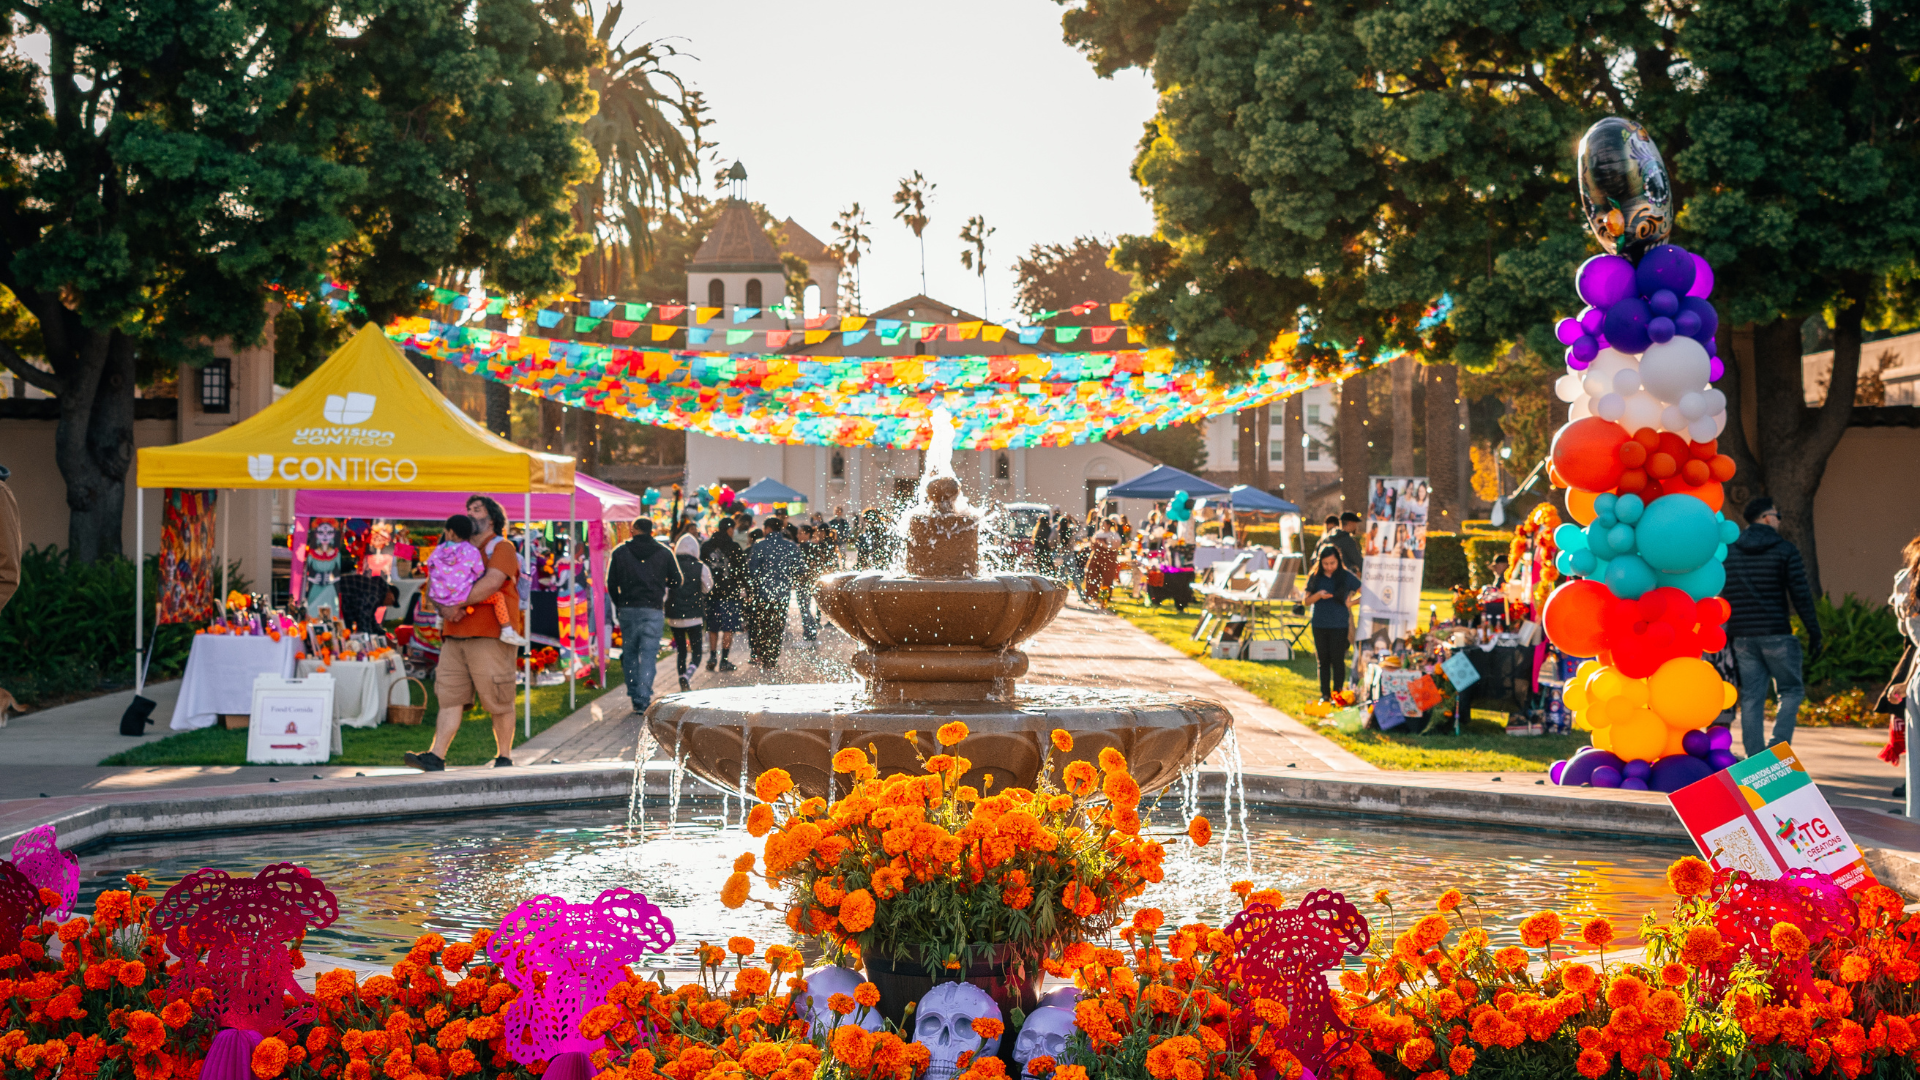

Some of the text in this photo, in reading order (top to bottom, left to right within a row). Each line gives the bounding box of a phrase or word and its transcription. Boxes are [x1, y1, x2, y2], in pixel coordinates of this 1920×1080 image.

[292, 436, 393, 447] CONTIGO
[278, 456, 418, 483] CONTIGO
[1741, 756, 1796, 786] DECORATIONS AND DESIGN
[1769, 773, 1778, 782] TO
[1777, 768, 1787, 778] YOU
[1786, 766, 1793, 774] BY
[1797, 817, 1831, 844] TG
[1807, 835, 1842, 857] CREATIONS
[1840, 873, 1865, 889] ORDINATOR
